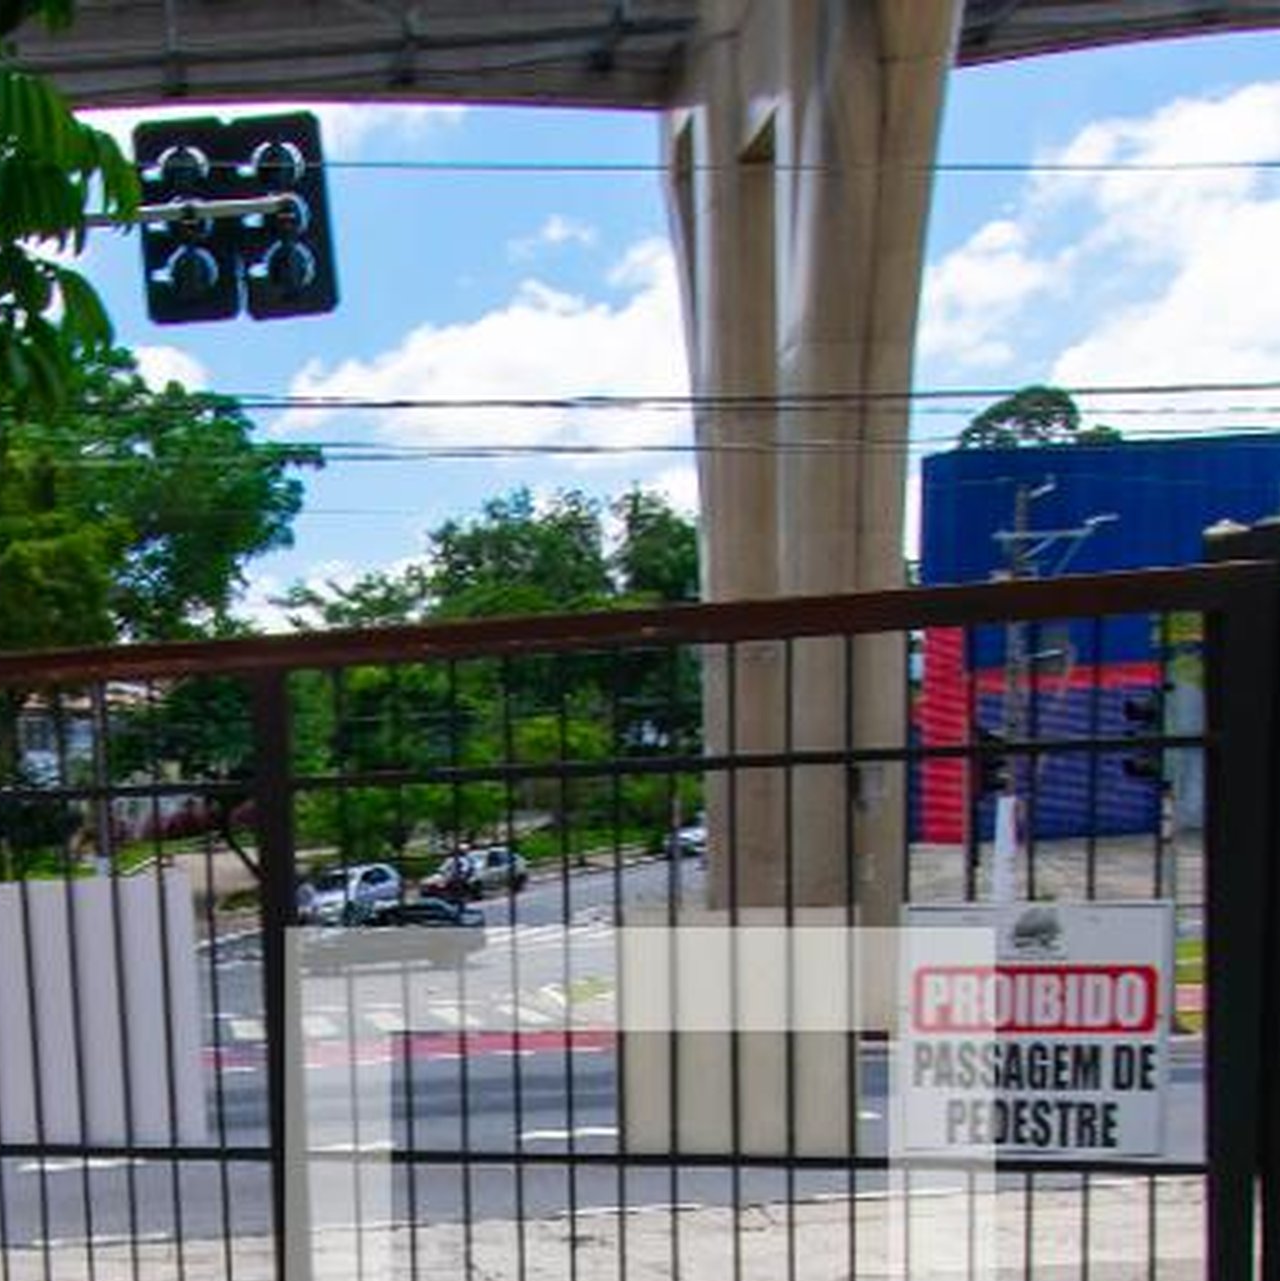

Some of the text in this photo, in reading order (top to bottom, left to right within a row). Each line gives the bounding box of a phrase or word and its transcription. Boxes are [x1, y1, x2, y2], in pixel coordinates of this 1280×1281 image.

[922, 972, 1146, 1027] PROIBIDO
[913, 1041, 1156, 1091] PASSAGEM DE
[947, 1099, 1118, 1148] PEDESTRE
